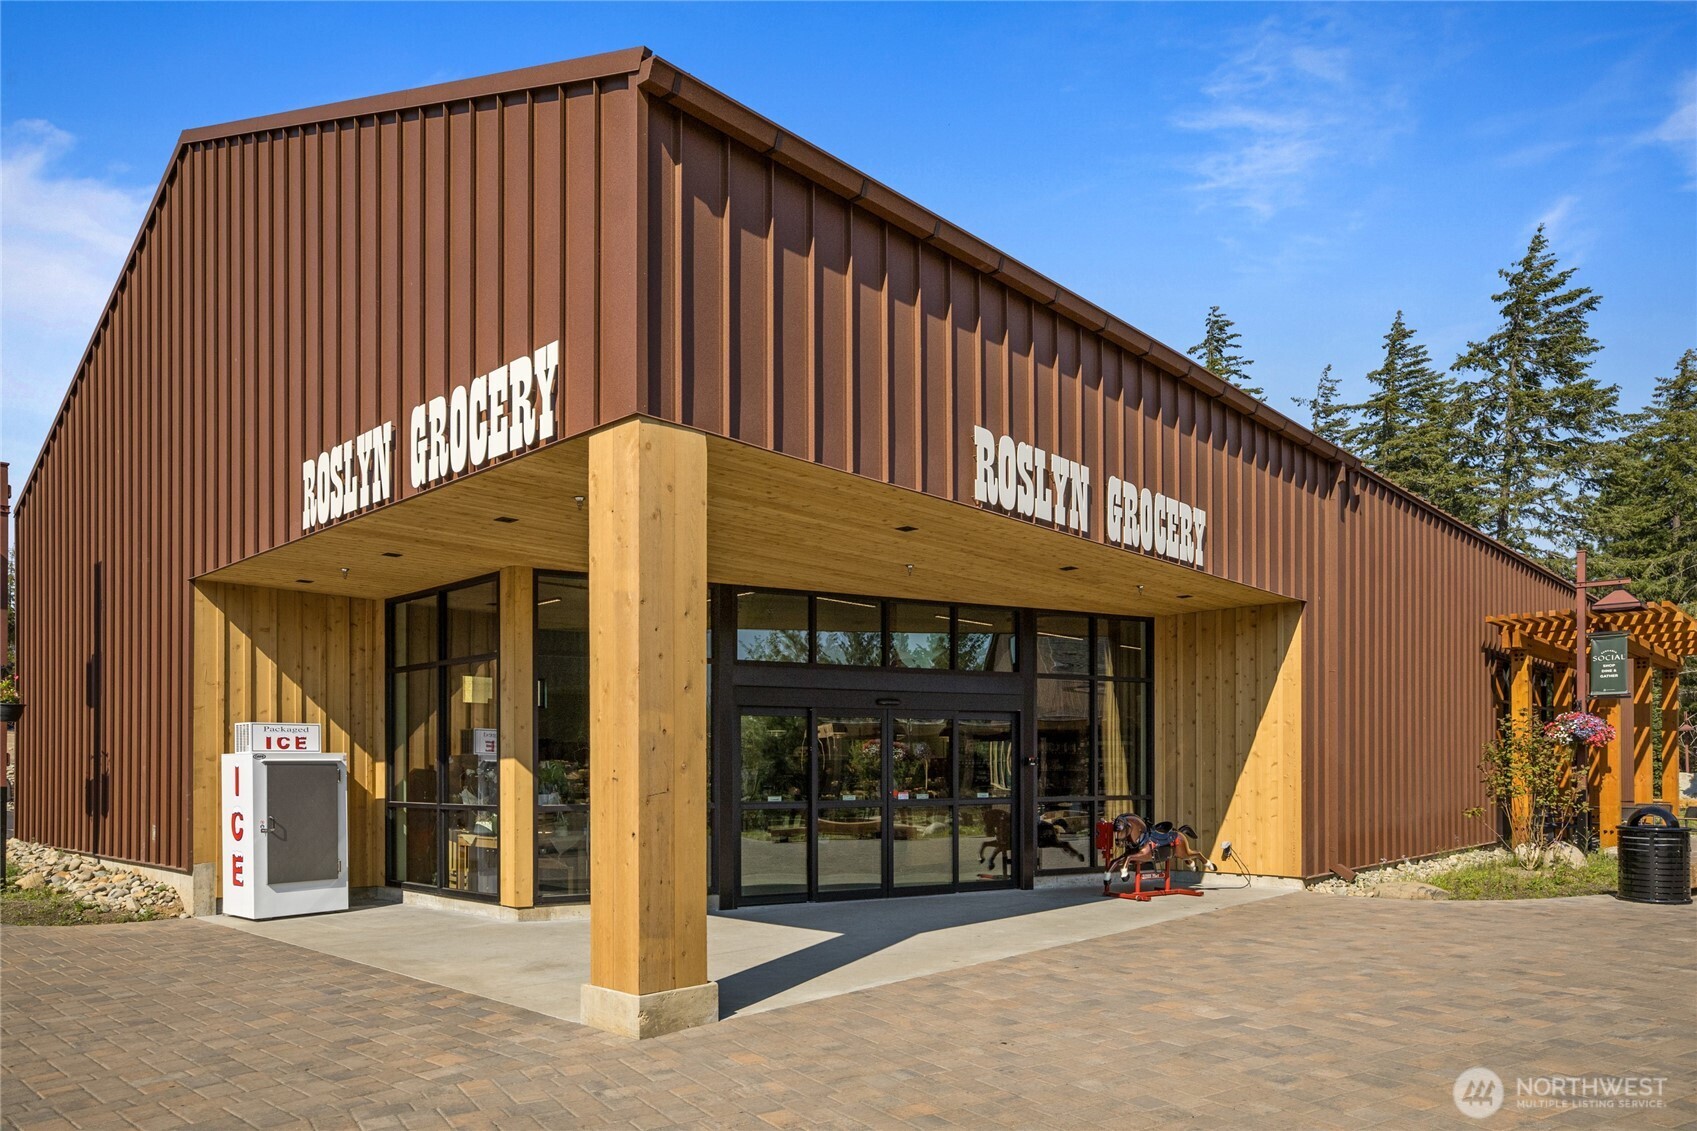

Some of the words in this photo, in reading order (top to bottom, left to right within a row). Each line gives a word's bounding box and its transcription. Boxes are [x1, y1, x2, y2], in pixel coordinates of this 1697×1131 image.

[303, 421, 392, 530] ROSLYN
[410, 340, 559, 488] GROCERY
[974, 425, 1090, 532] ROSLYN
[1107, 475, 1206, 566] GROCERY
[266, 736, 307, 750] ICE
[231, 764, 244, 887] ICE
